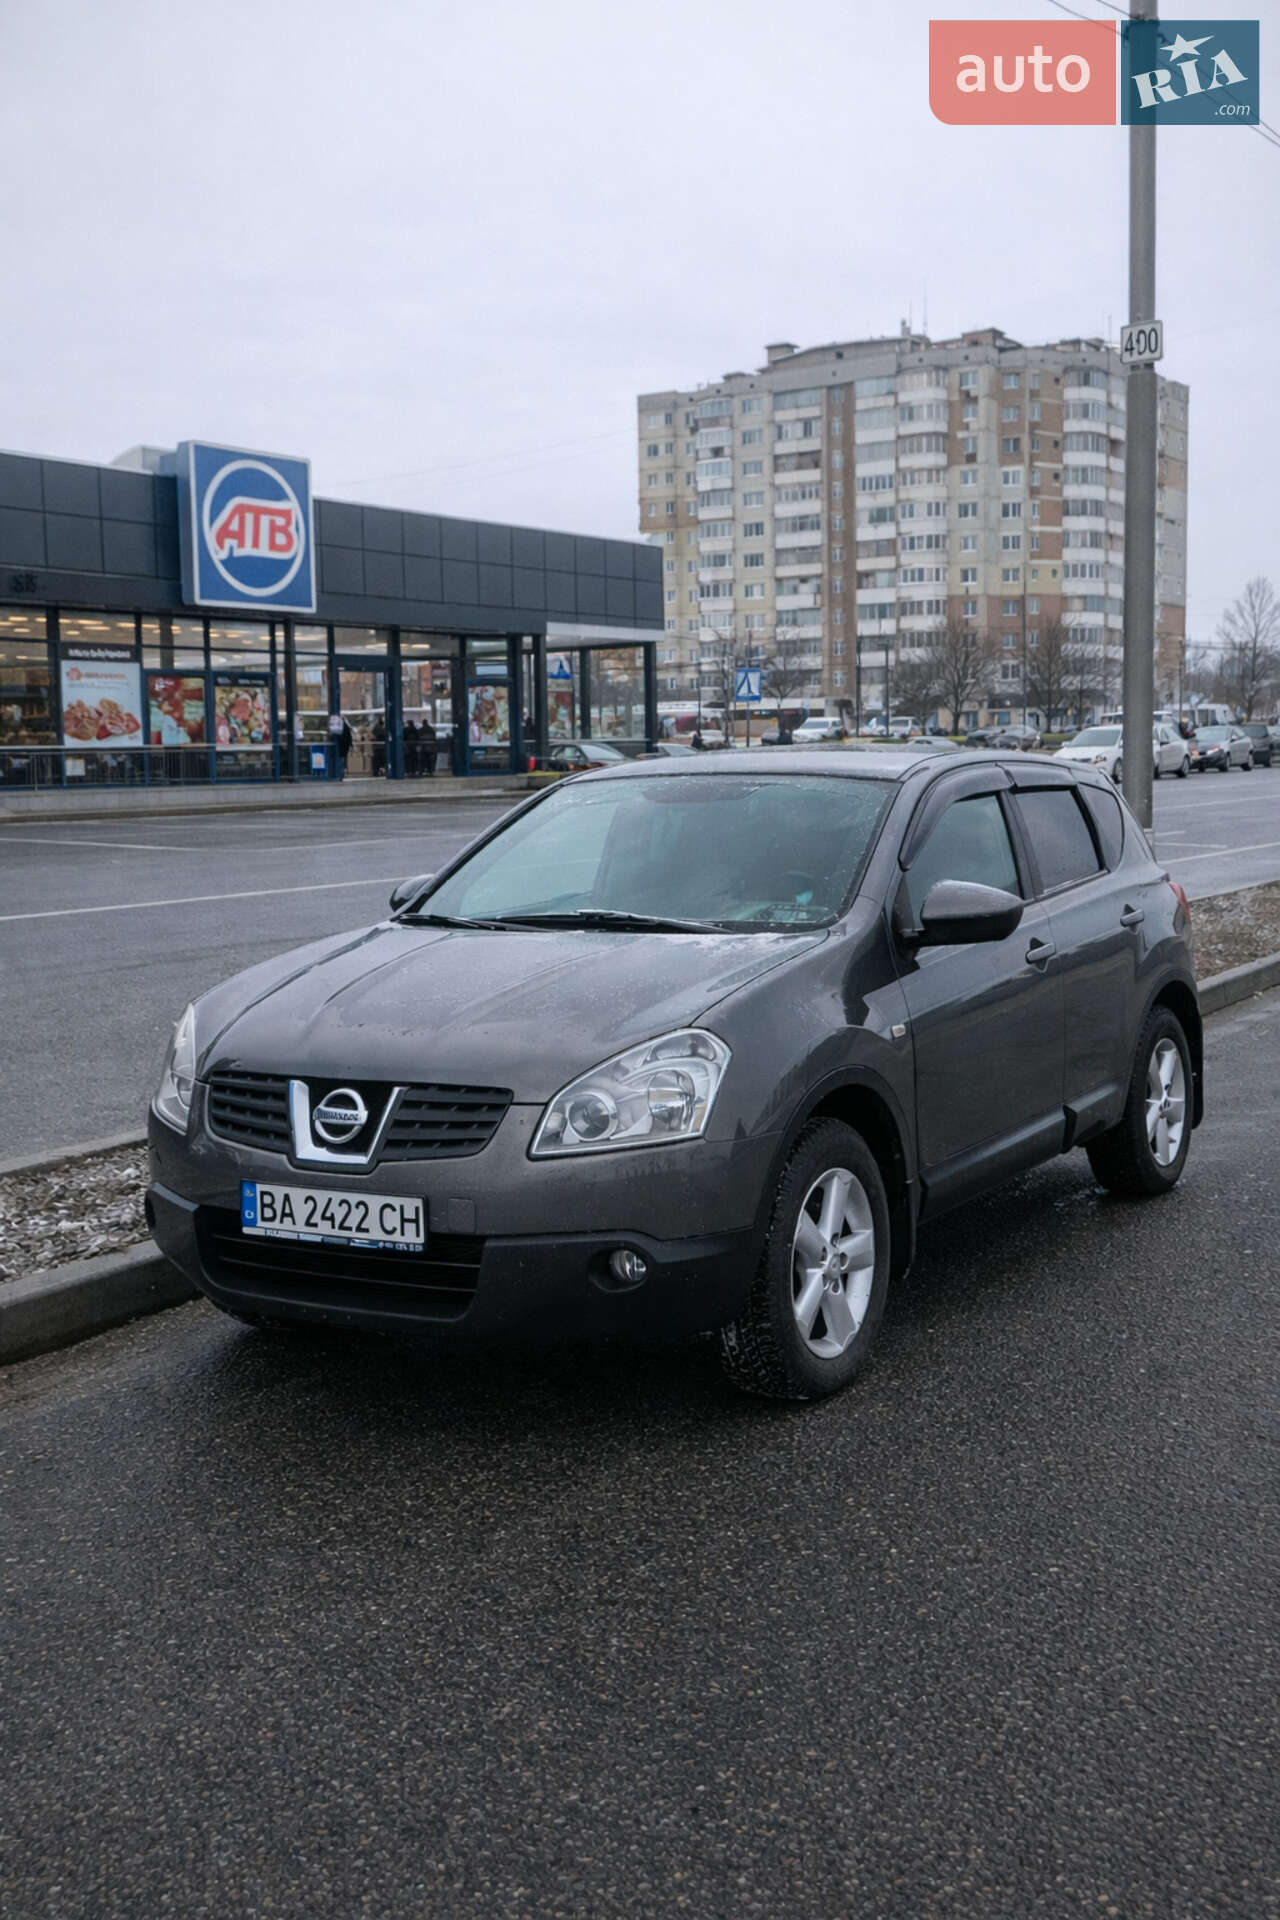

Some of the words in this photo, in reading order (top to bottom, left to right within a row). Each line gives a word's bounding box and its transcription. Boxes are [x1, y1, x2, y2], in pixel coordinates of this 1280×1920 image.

[1124, 327, 1158, 357] 400
[259, 1190, 296, 1226] BA
[303, 1195, 370, 1234] 2422
[379, 1202, 420, 1238] CH
